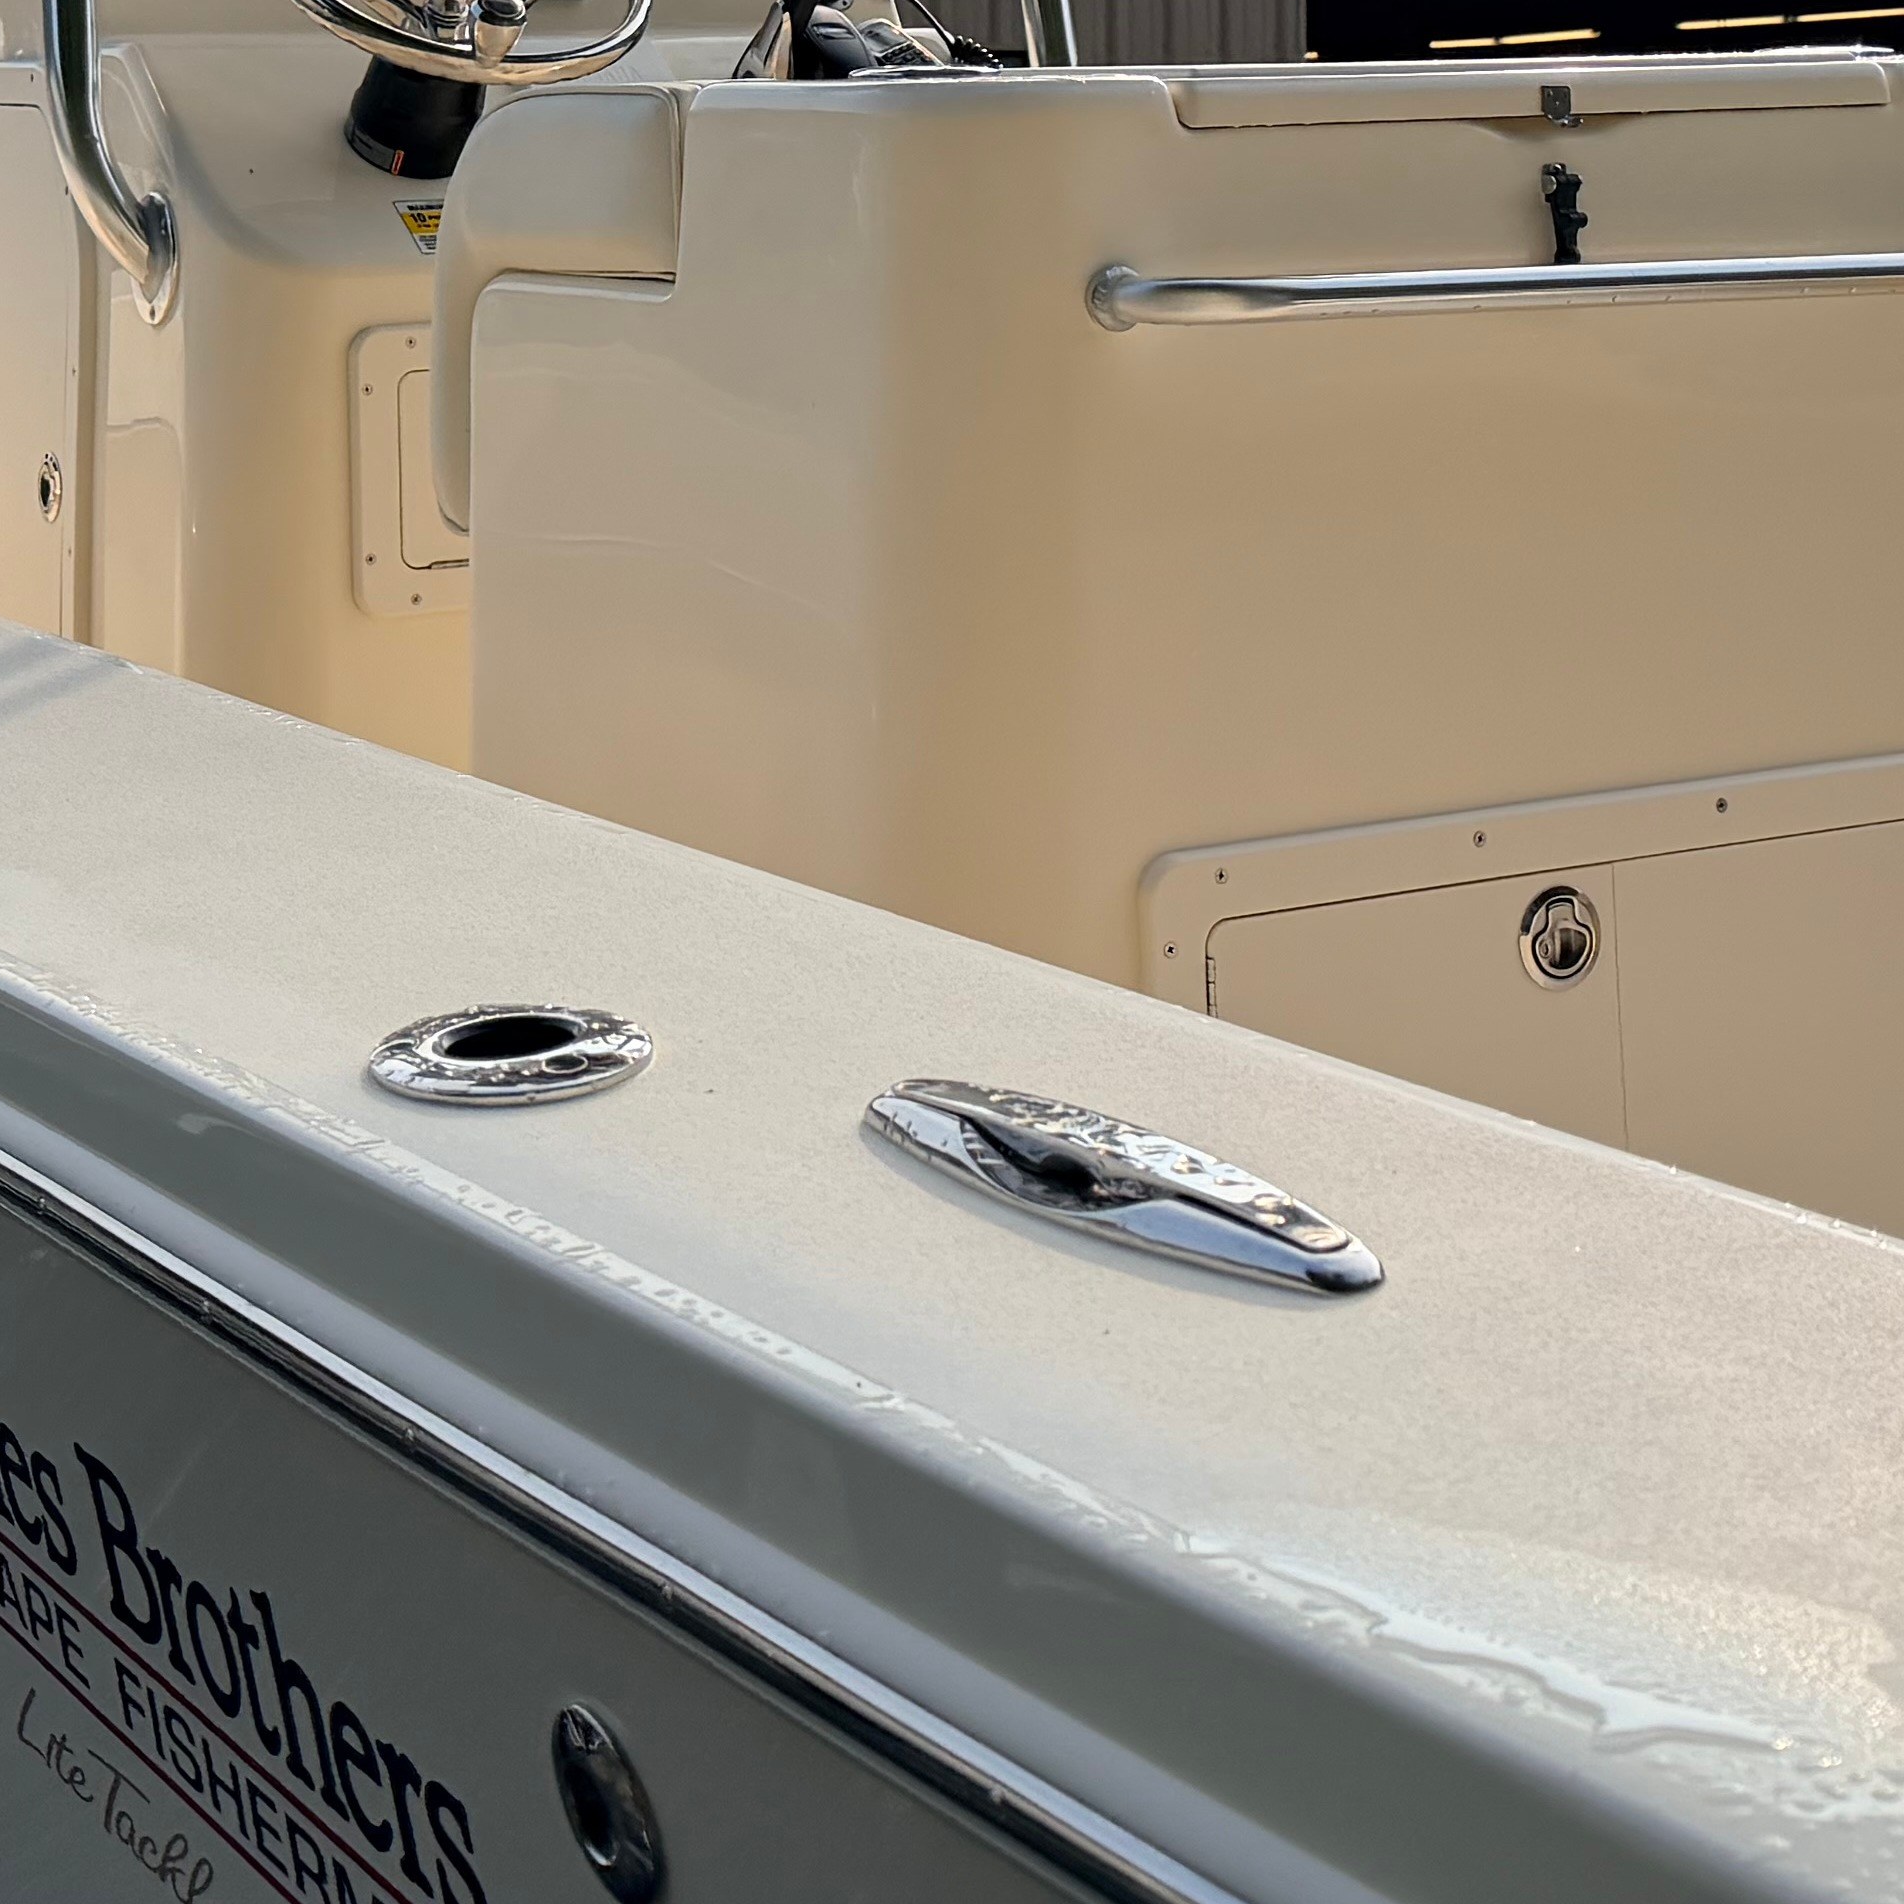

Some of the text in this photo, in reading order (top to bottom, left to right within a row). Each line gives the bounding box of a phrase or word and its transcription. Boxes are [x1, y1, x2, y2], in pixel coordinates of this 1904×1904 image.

[409, 212, 427, 223] 10
[73, 1441, 488, 1904] Brothers
[16, 1686, 95, 1804] Lite
